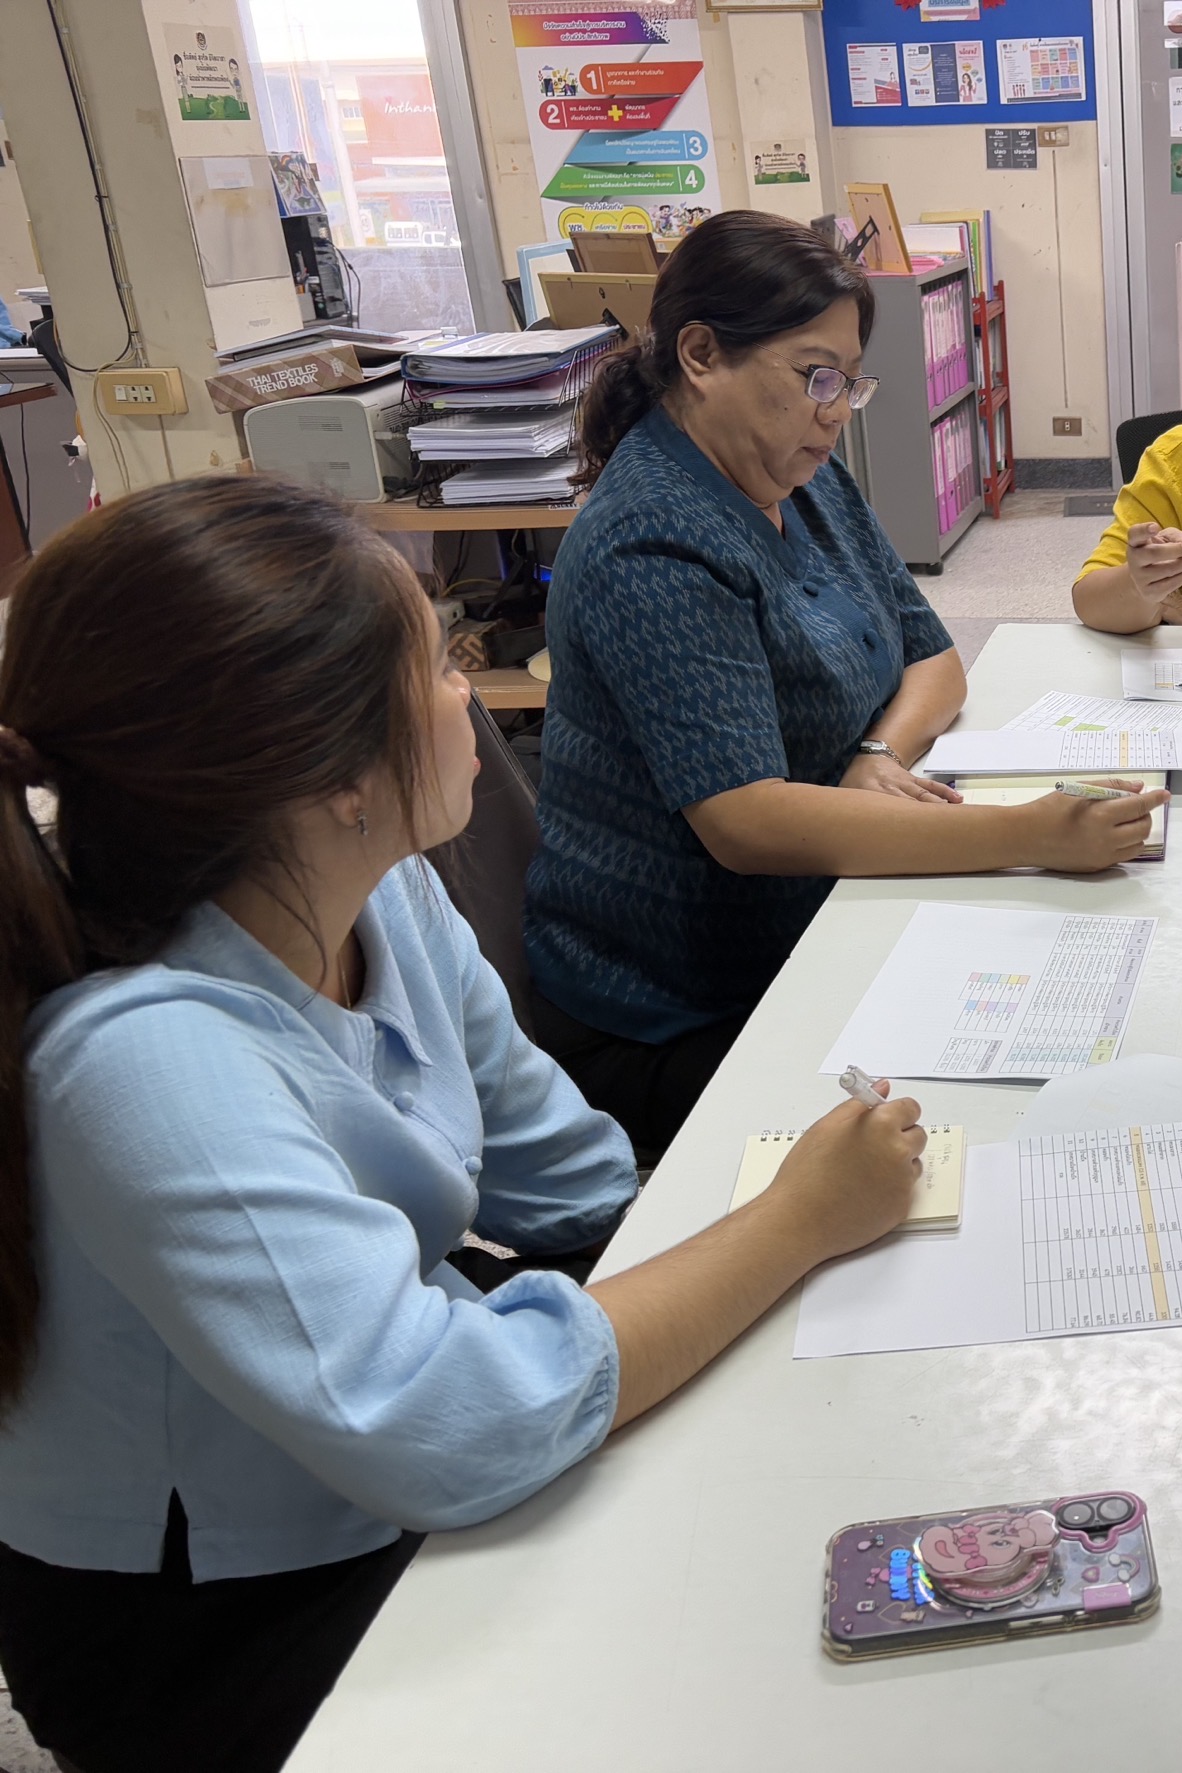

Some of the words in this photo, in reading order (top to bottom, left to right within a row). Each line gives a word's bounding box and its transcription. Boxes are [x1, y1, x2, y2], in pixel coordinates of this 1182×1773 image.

[586, 70, 597, 90] 1
[546, 104, 560, 124] 2
[689, 137, 702, 156] 3
[685, 170, 698, 188] 4
[246, 374, 271, 387] THAI
[271, 363, 319, 380] TEXTILES
[254, 378, 288, 395] TREND
[288, 373, 318, 388] BOOK
